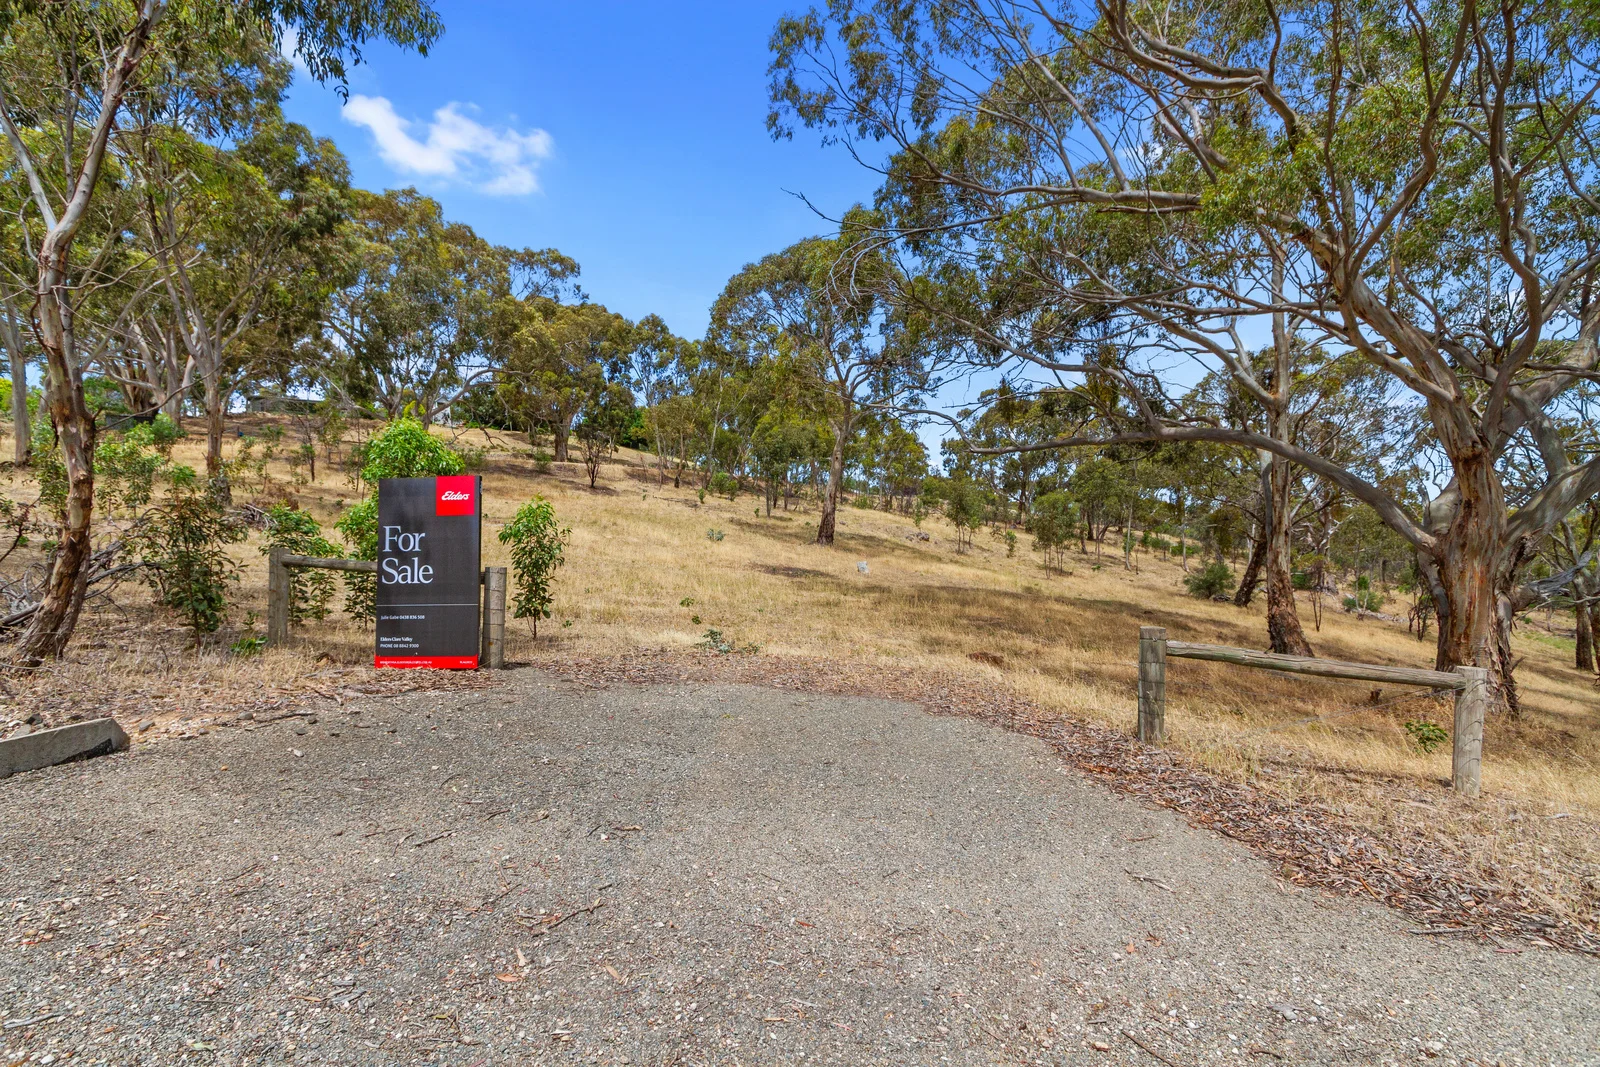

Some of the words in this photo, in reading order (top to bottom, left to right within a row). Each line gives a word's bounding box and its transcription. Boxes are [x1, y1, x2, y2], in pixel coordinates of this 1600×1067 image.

[441, 491, 470, 501] Elders
[382, 525, 426, 552] For
[381, 557, 434, 585] Sale
